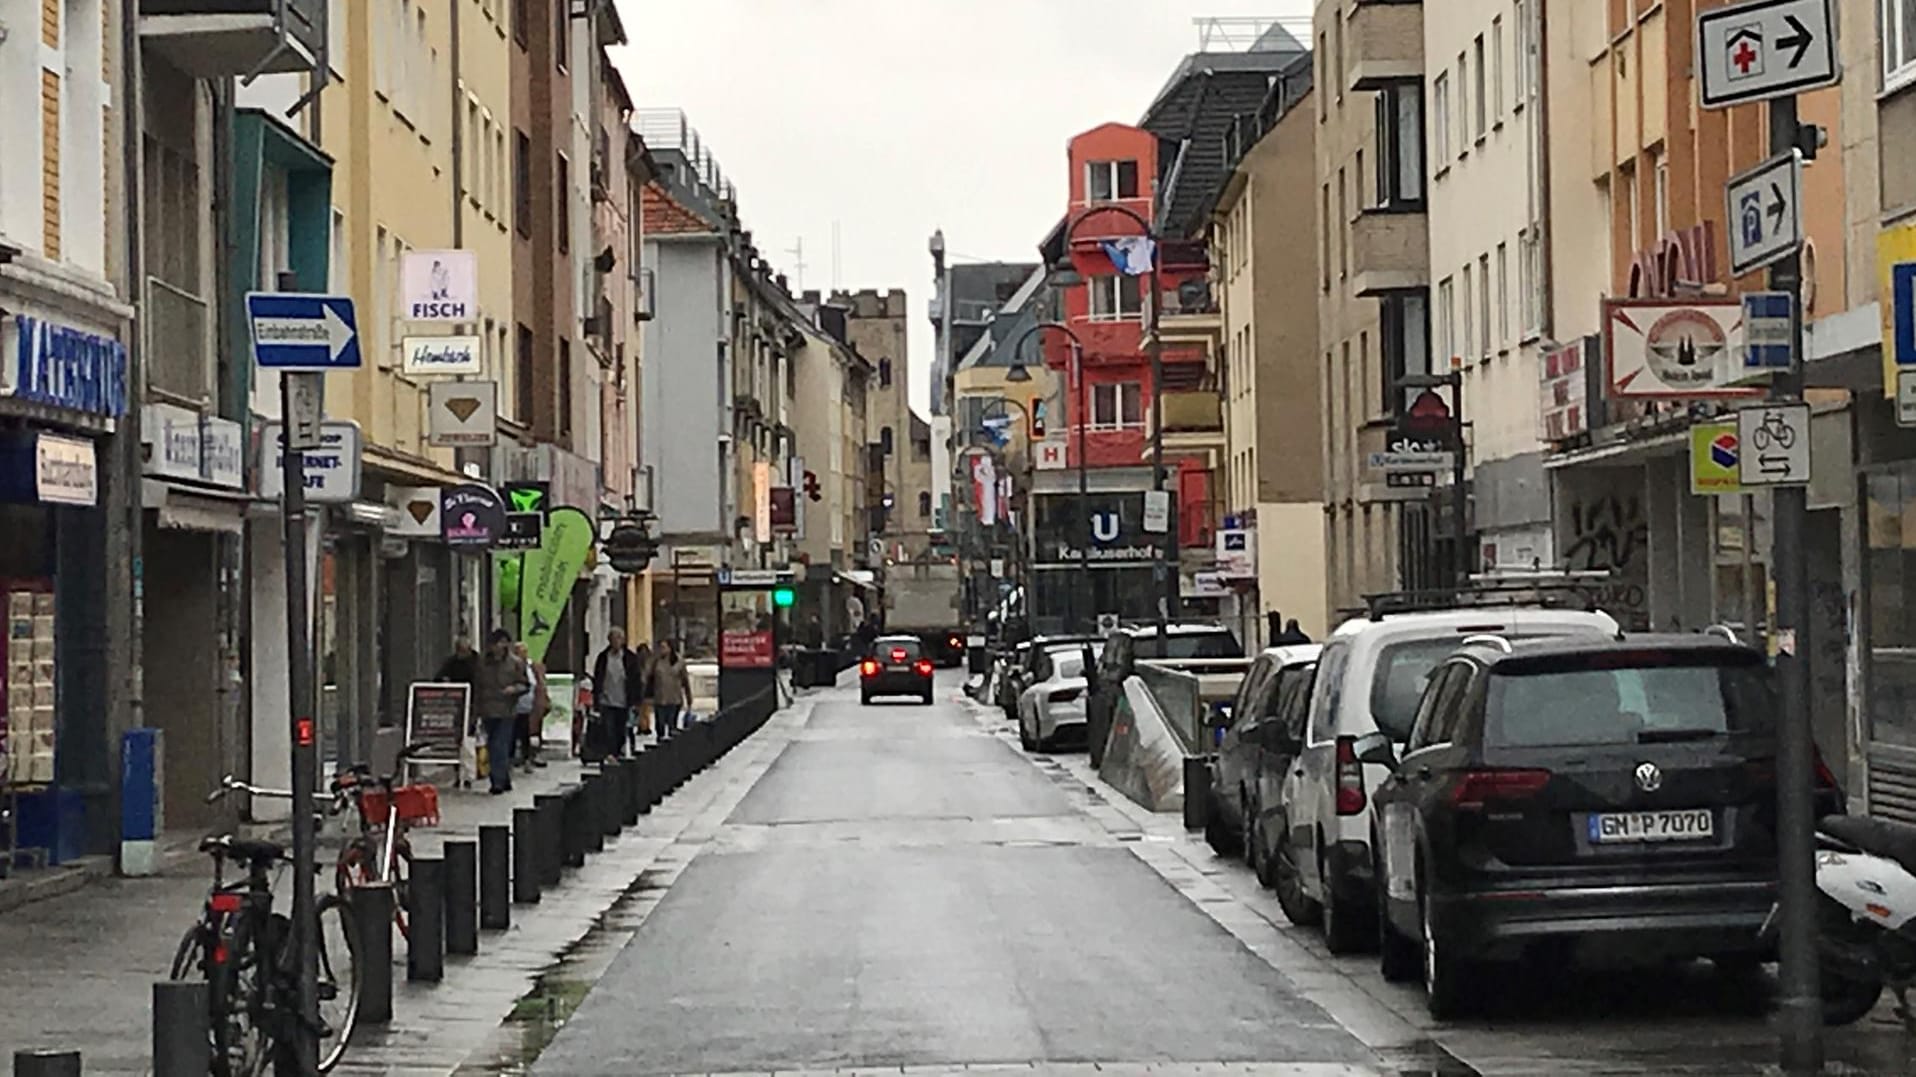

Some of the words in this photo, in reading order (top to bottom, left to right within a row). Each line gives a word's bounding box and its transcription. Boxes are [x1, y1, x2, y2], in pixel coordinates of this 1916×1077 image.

[413, 303, 465, 318] FISCH
[1043, 447, 1058, 462] H
[1093, 513, 1119, 541] U
[1601, 815, 1629, 836] GM
[1642, 814, 1655, 833] P
[1658, 812, 1710, 833] 7070
